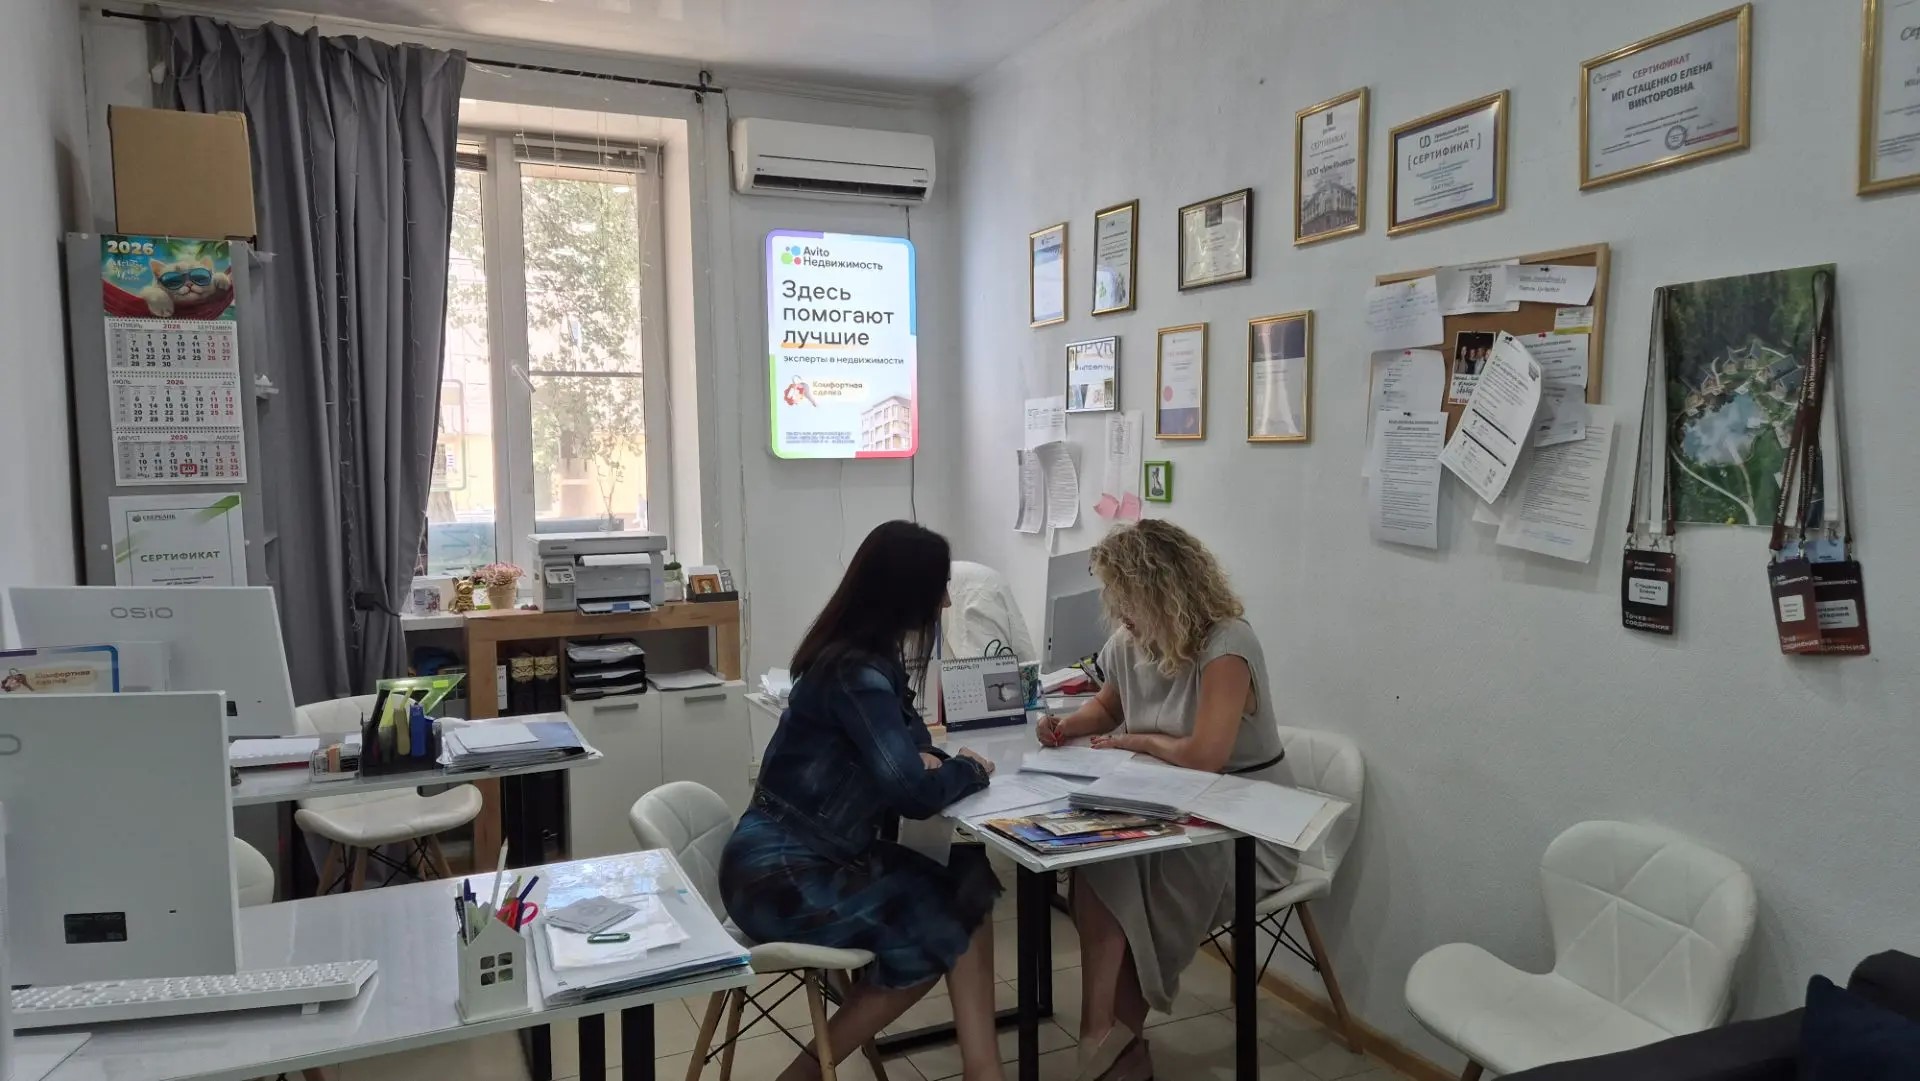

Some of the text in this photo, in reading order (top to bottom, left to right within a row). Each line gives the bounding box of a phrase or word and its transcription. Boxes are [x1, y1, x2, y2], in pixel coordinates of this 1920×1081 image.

[1632, 52, 1691, 80] СЕРТИФИКАТ
[1611, 88, 1626, 102] ИП
[1626, 71, 1679, 98] СТАЦЕНКО
[1679, 60, 1713, 82] ЕЛЕНА
[1628, 81, 1695, 111] ВИКТОРОВНА
[106, 240, 154, 256] 2026
[804, 246, 830, 258] Avito
[803, 257, 883, 270] Недвижимость
[782, 280, 851, 302] Здесь
[783, 307, 895, 324] помогают
[783, 330, 870, 348] лучшие
[784, 355, 828, 364] эксперты
[836, 356, 904, 365] недвижимости
[140, 550, 220, 562] СЕРТИФИКАТ
